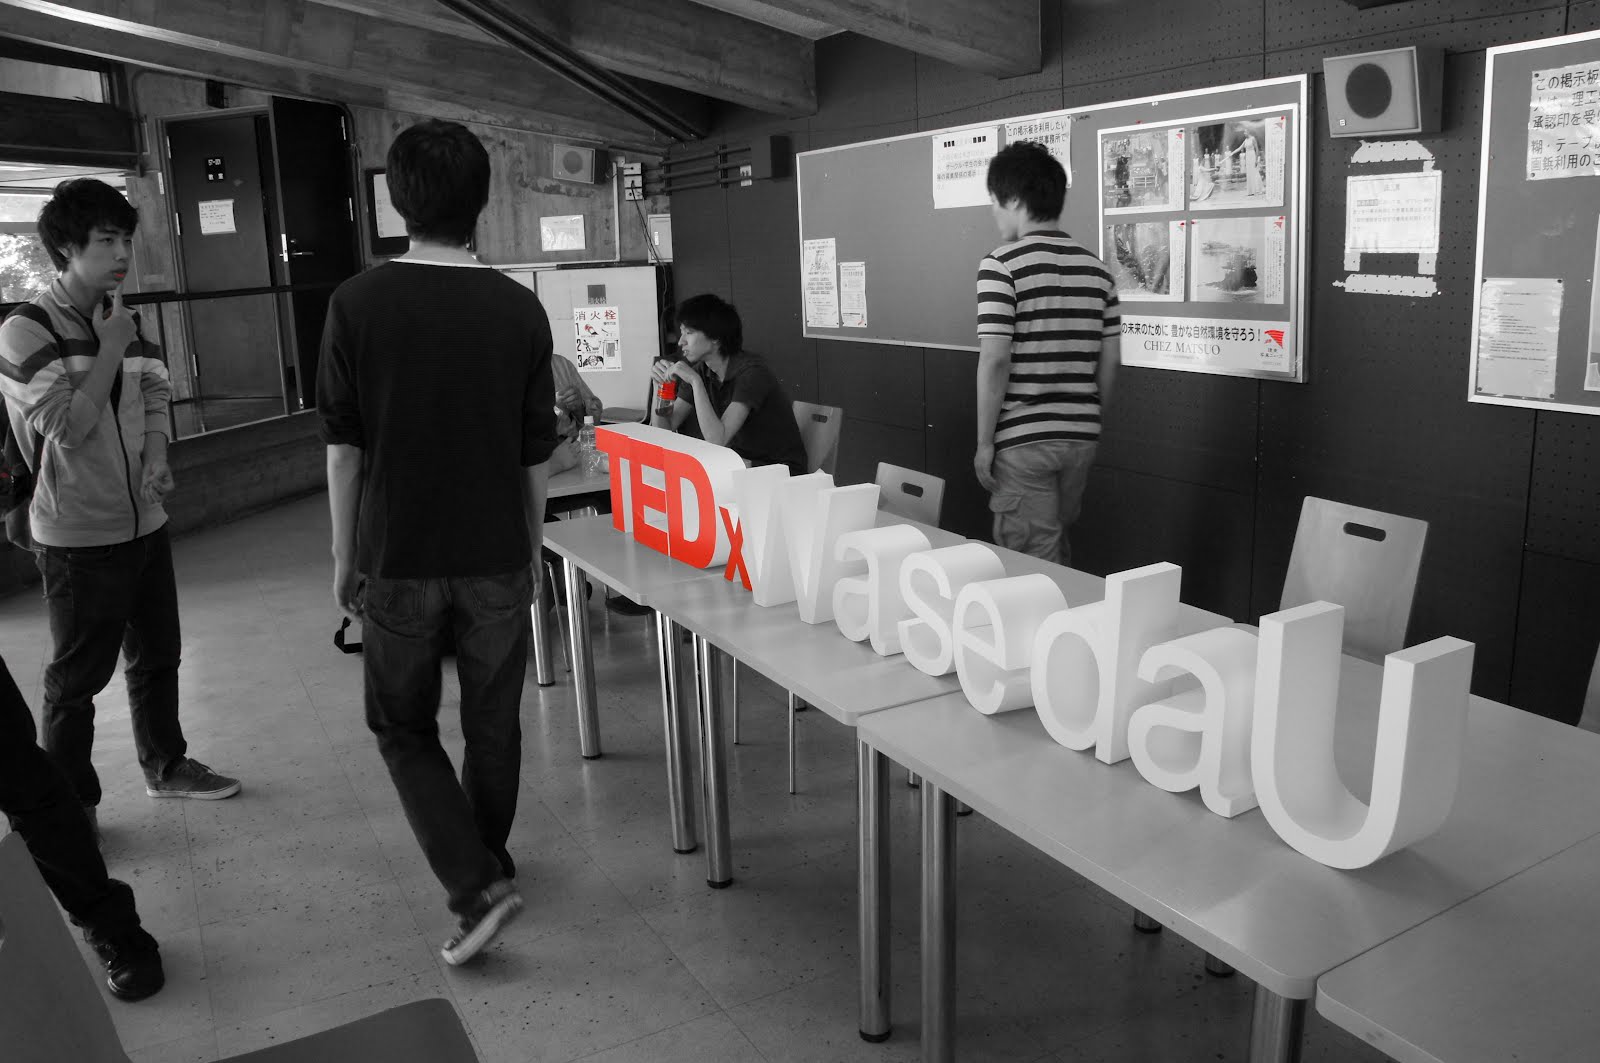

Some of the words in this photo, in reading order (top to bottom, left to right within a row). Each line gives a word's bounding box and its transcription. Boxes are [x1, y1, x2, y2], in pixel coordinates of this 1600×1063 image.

[1008, 121, 1067, 137] この掲示板を利用したい
[575, 310, 616, 321] 消火栓
[575, 323, 580, 335] 1
[576, 338, 582, 352] 2
[1143, 340, 1172, 352] CHEZ
[1175, 342, 1221, 356] MATSUO
[577, 354, 582, 367] 3
